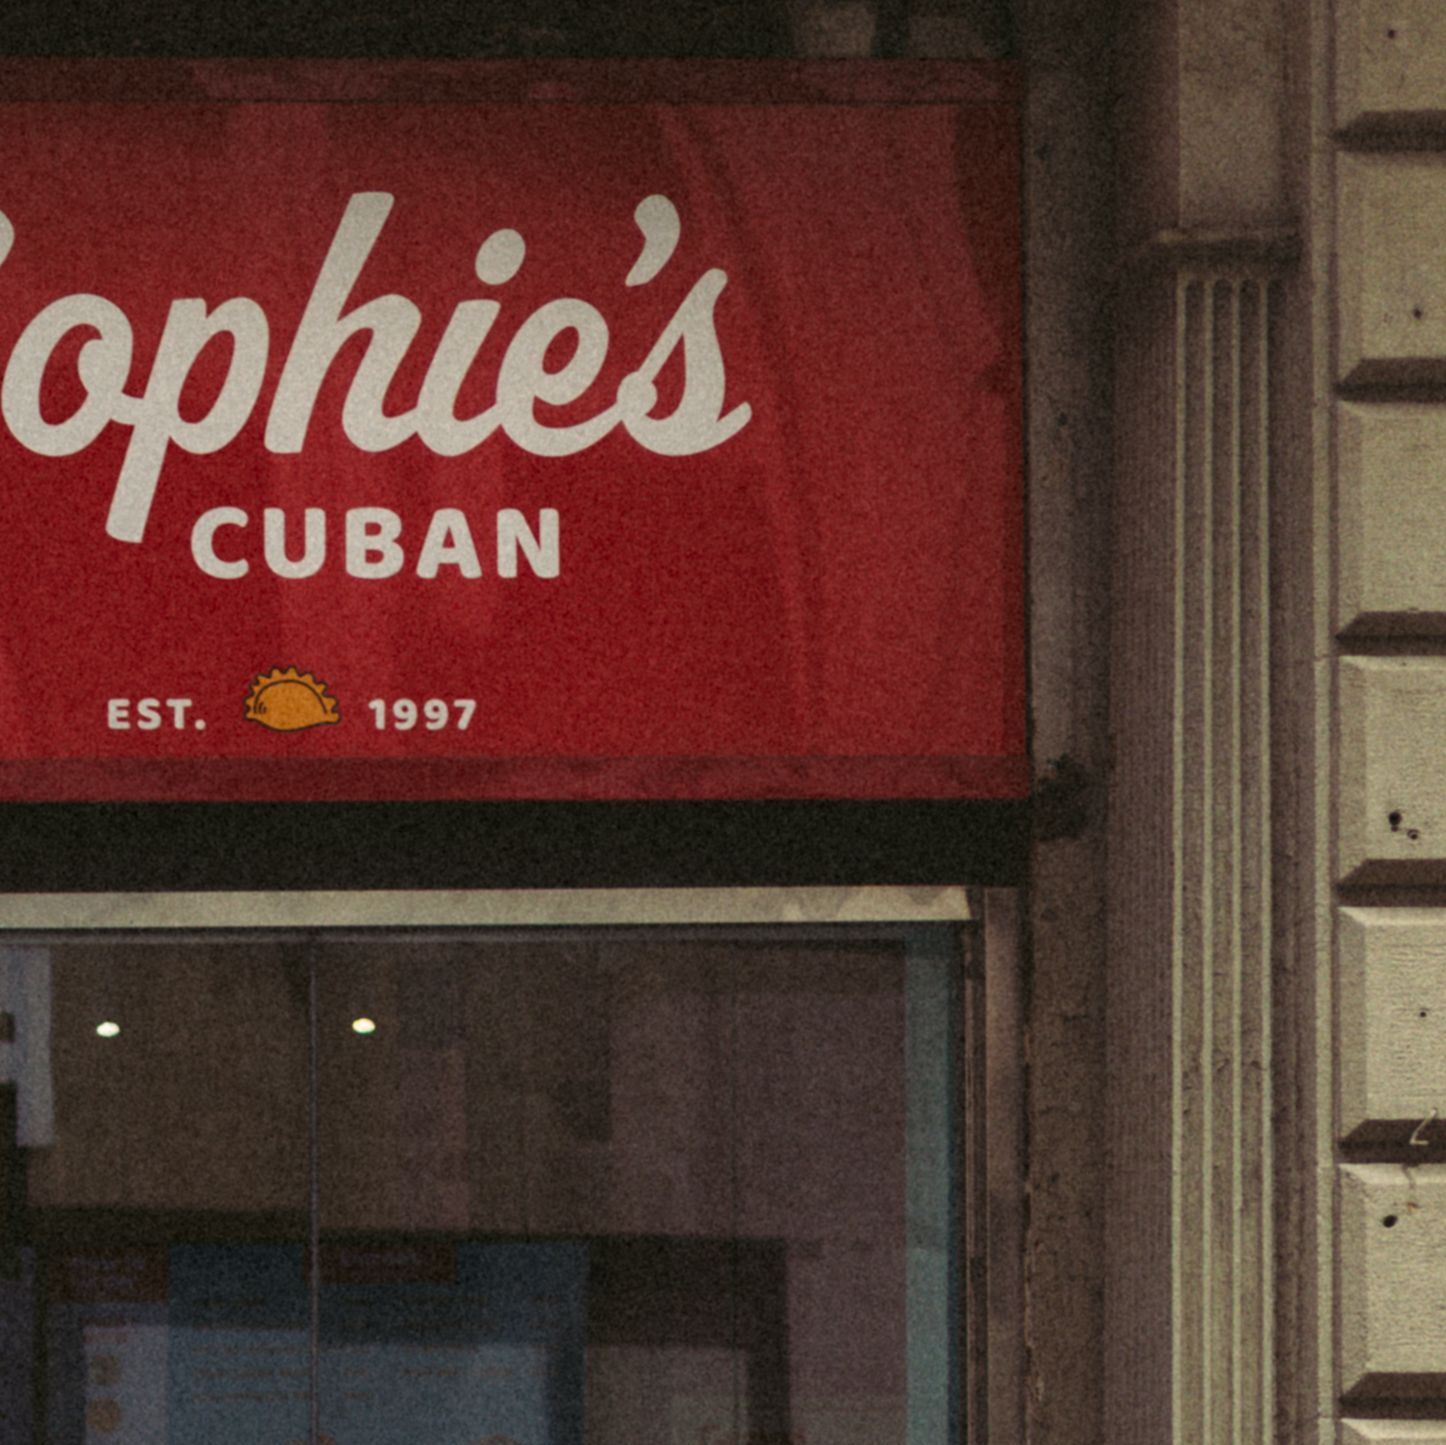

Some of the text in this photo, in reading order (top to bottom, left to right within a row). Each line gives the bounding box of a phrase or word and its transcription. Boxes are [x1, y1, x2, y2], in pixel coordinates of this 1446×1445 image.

[189, 505, 563, 582] CUBAN
[106, 697, 478, 733] EST. 1997
